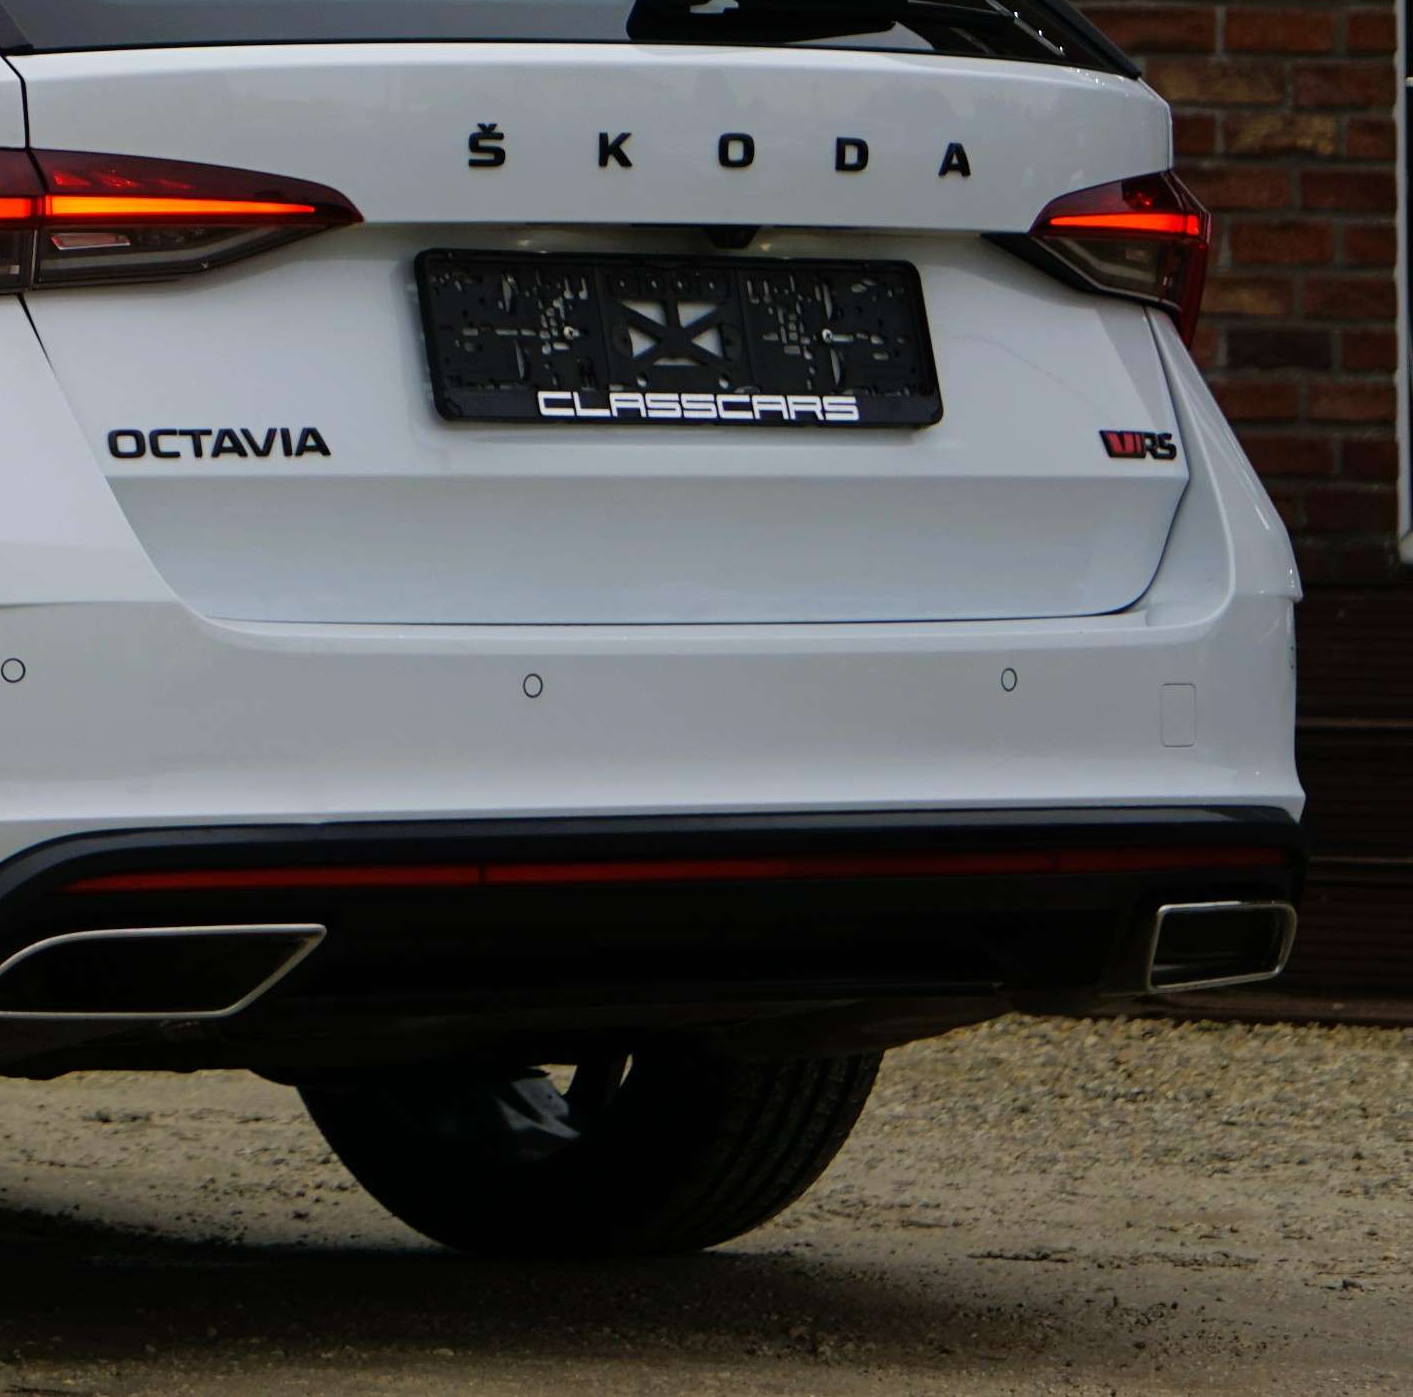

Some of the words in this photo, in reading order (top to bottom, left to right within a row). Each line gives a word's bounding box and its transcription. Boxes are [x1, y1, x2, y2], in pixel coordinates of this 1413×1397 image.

[467, 122, 973, 178] ŠKODA
[537, 391, 859, 423] CLASSCARS
[107, 427, 332, 459] OCTAVIA
